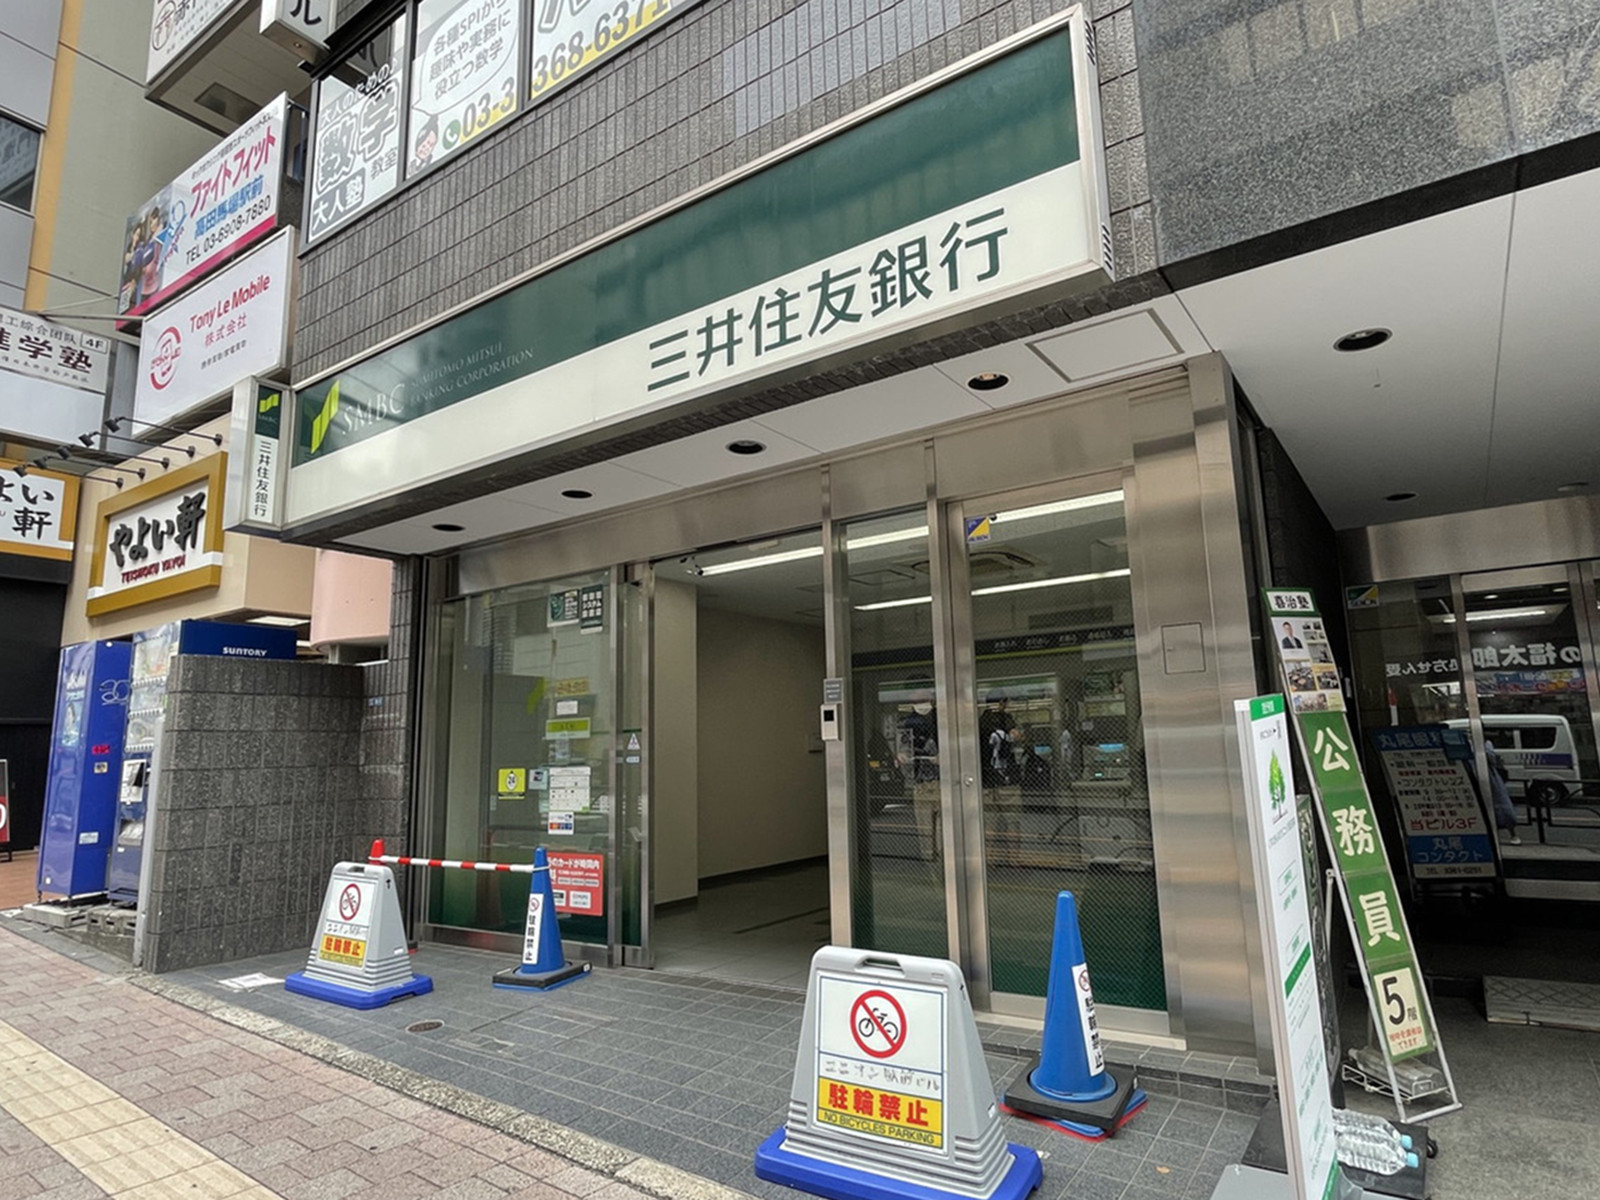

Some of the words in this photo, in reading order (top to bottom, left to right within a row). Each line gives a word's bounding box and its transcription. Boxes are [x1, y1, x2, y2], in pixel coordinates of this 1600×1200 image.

[435, 37, 504, 100] 役立つ数学
[190, 125, 276, 218] ファイトフィット
[195, 174, 264, 240] 高田馬場駅前
[312, 175, 363, 230] 大人塾
[186, 242, 201, 265] TEL
[203, 195, 271, 254] 03-6908-7880
[190, 307, 216, 333] Tony
[217, 299, 230, 319] Le
[231, 274, 271, 311] Mobile
[648, 207, 1009, 392] 三井住友銀行
[204, 312, 247, 347] 株式会社
[463, 341, 503, 366] MITSUI
[456, 347, 533, 388] CORPORATION
[342, 383, 406, 435] SMBC
[255, 441, 272, 517] 三井住友銀行
[12, 506, 52, 540] 軒
[109, 491, 206, 568] やよい軒
[222, 646, 267, 657] SUNTORY
[1314, 727, 1400, 947] 公務員
[1411, 819, 1477, 830] 当ビル3F
[1418, 851, 1484, 862] コンタクト
[824, 1112, 838, 1123] NO
[839, 1115, 886, 1134] BICYCLES
[888, 1127, 935, 1145] PARKING
[828, 1083, 929, 1127] 駐輪禁止
